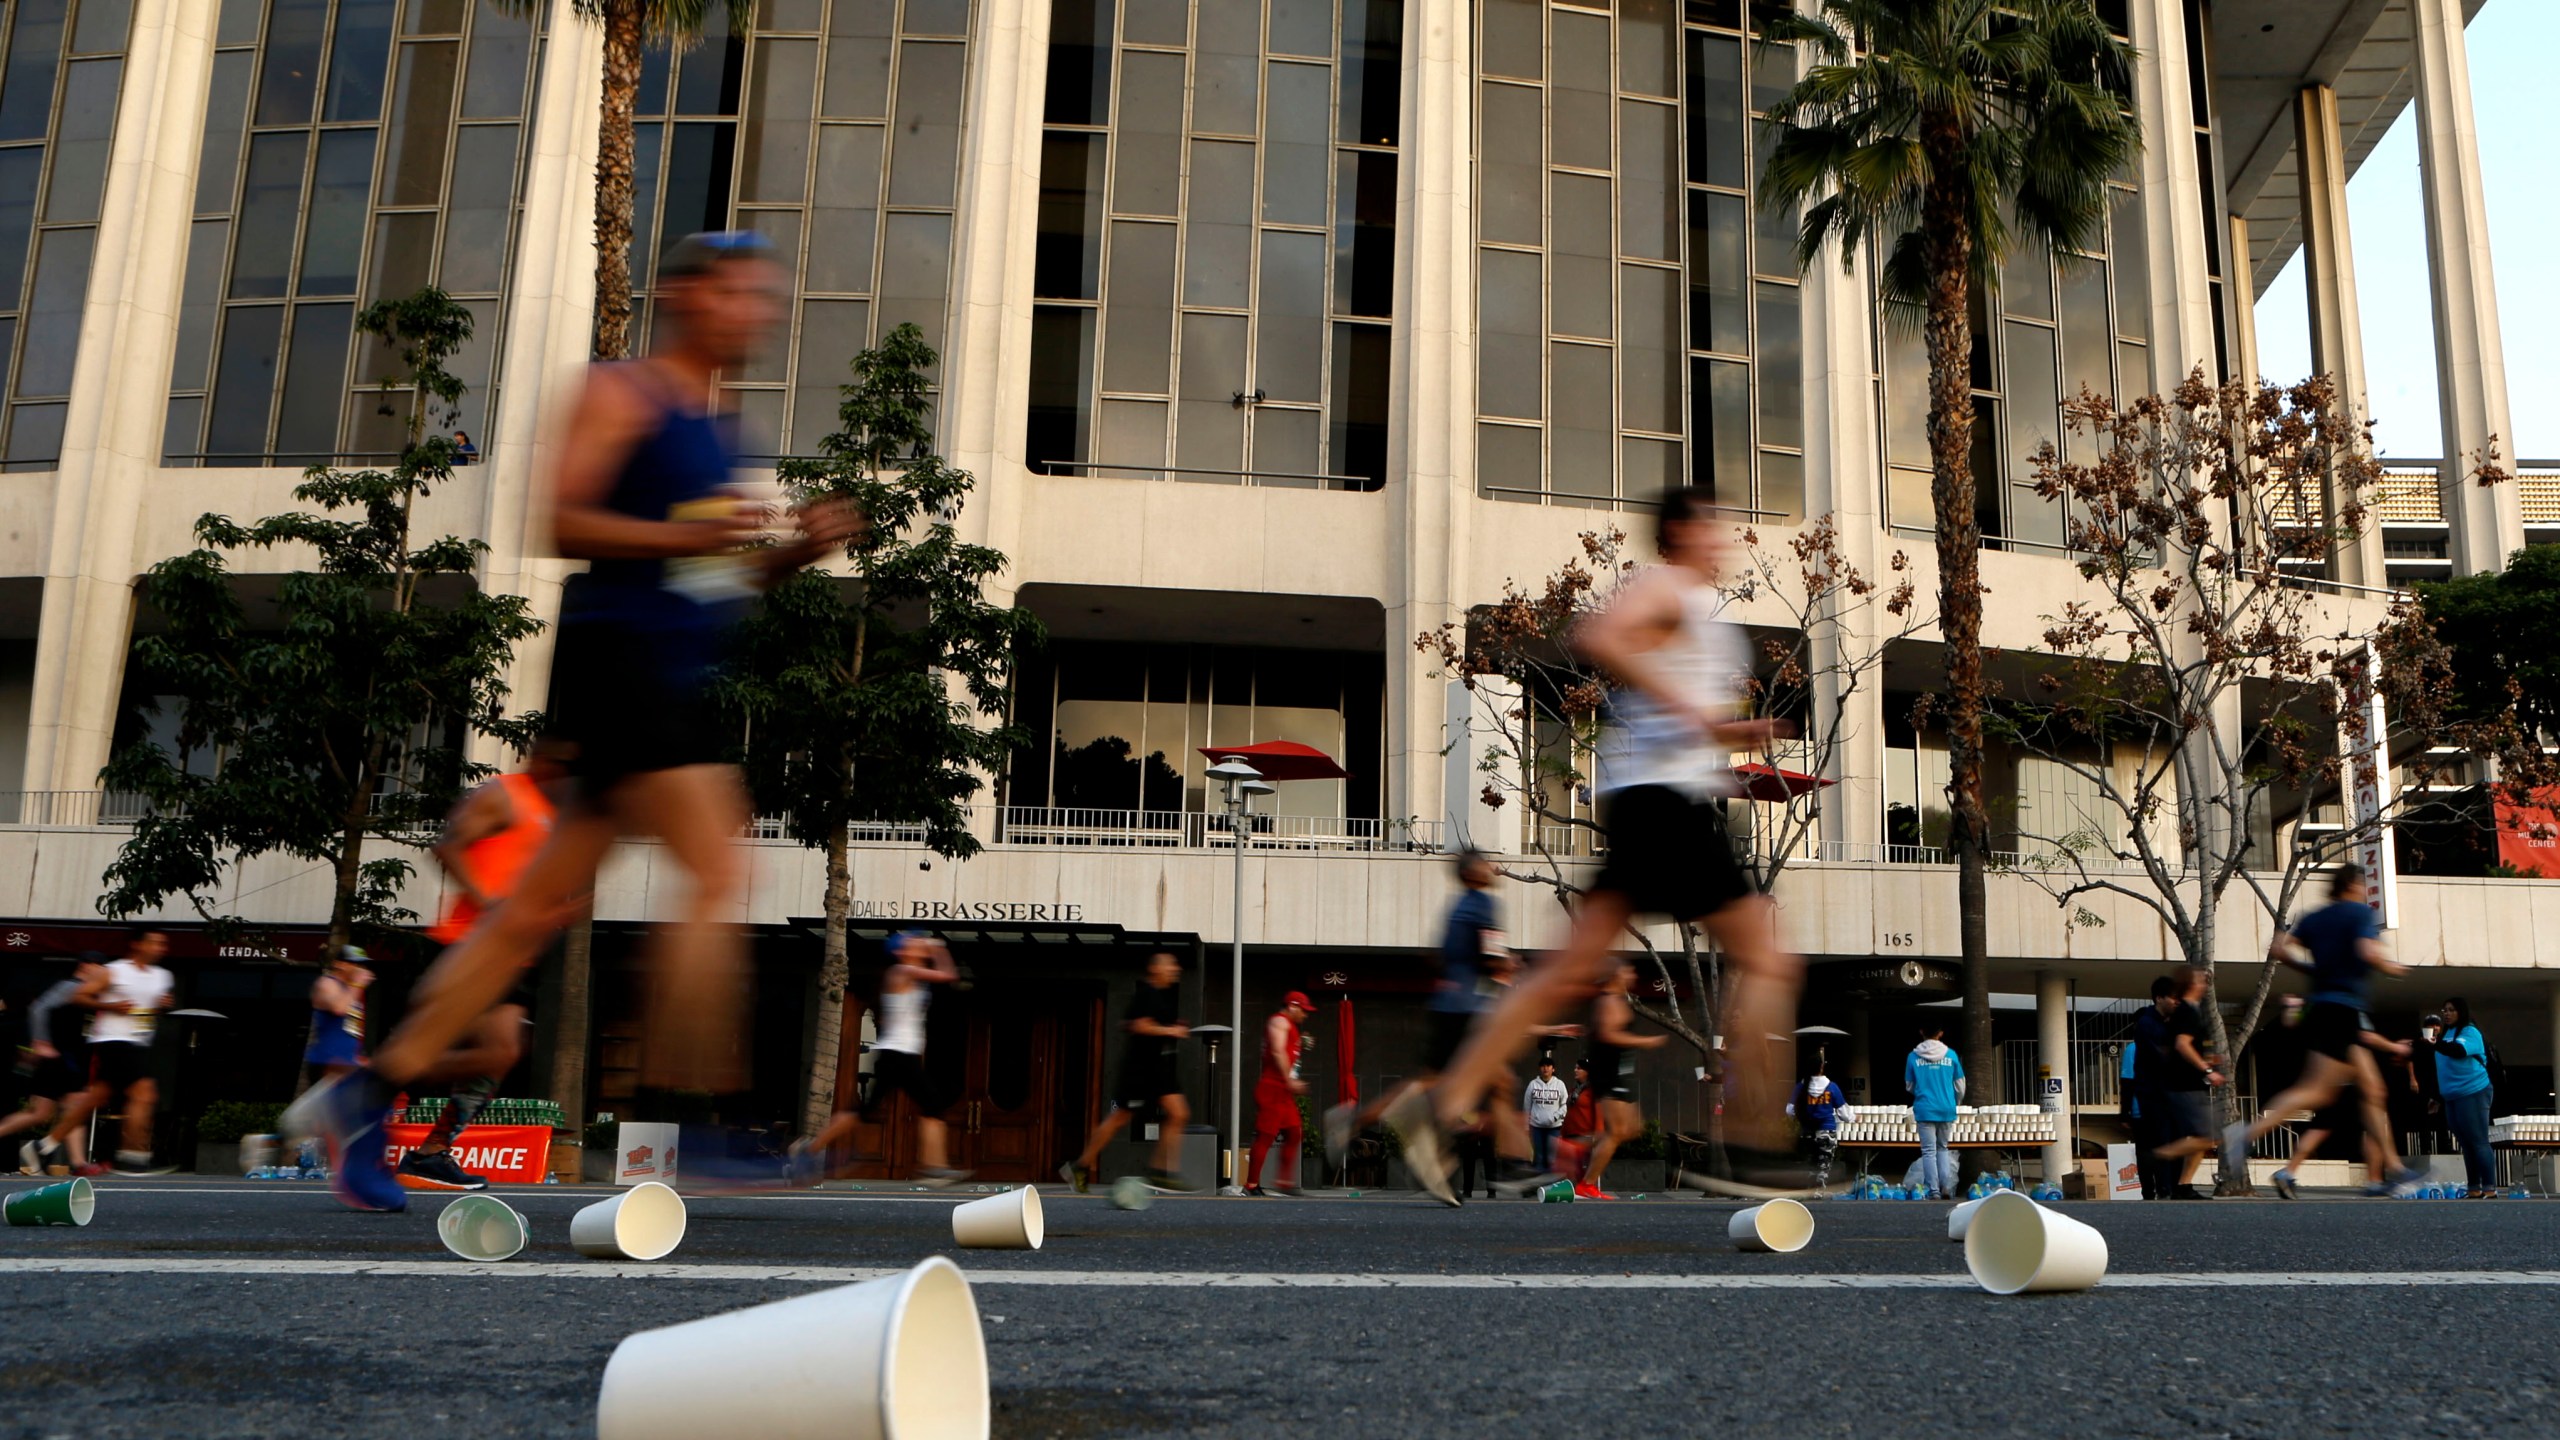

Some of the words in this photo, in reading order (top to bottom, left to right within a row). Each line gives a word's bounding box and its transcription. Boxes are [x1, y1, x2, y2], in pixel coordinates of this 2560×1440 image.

[2528, 840, 2556, 848] CENTER
[847, 900, 899, 918] NDALL'S
[910, 901, 1083, 921] BRASSERIE
[1884, 933, 1913, 947] 165
[384, 1145, 528, 1170] ENRANCE
